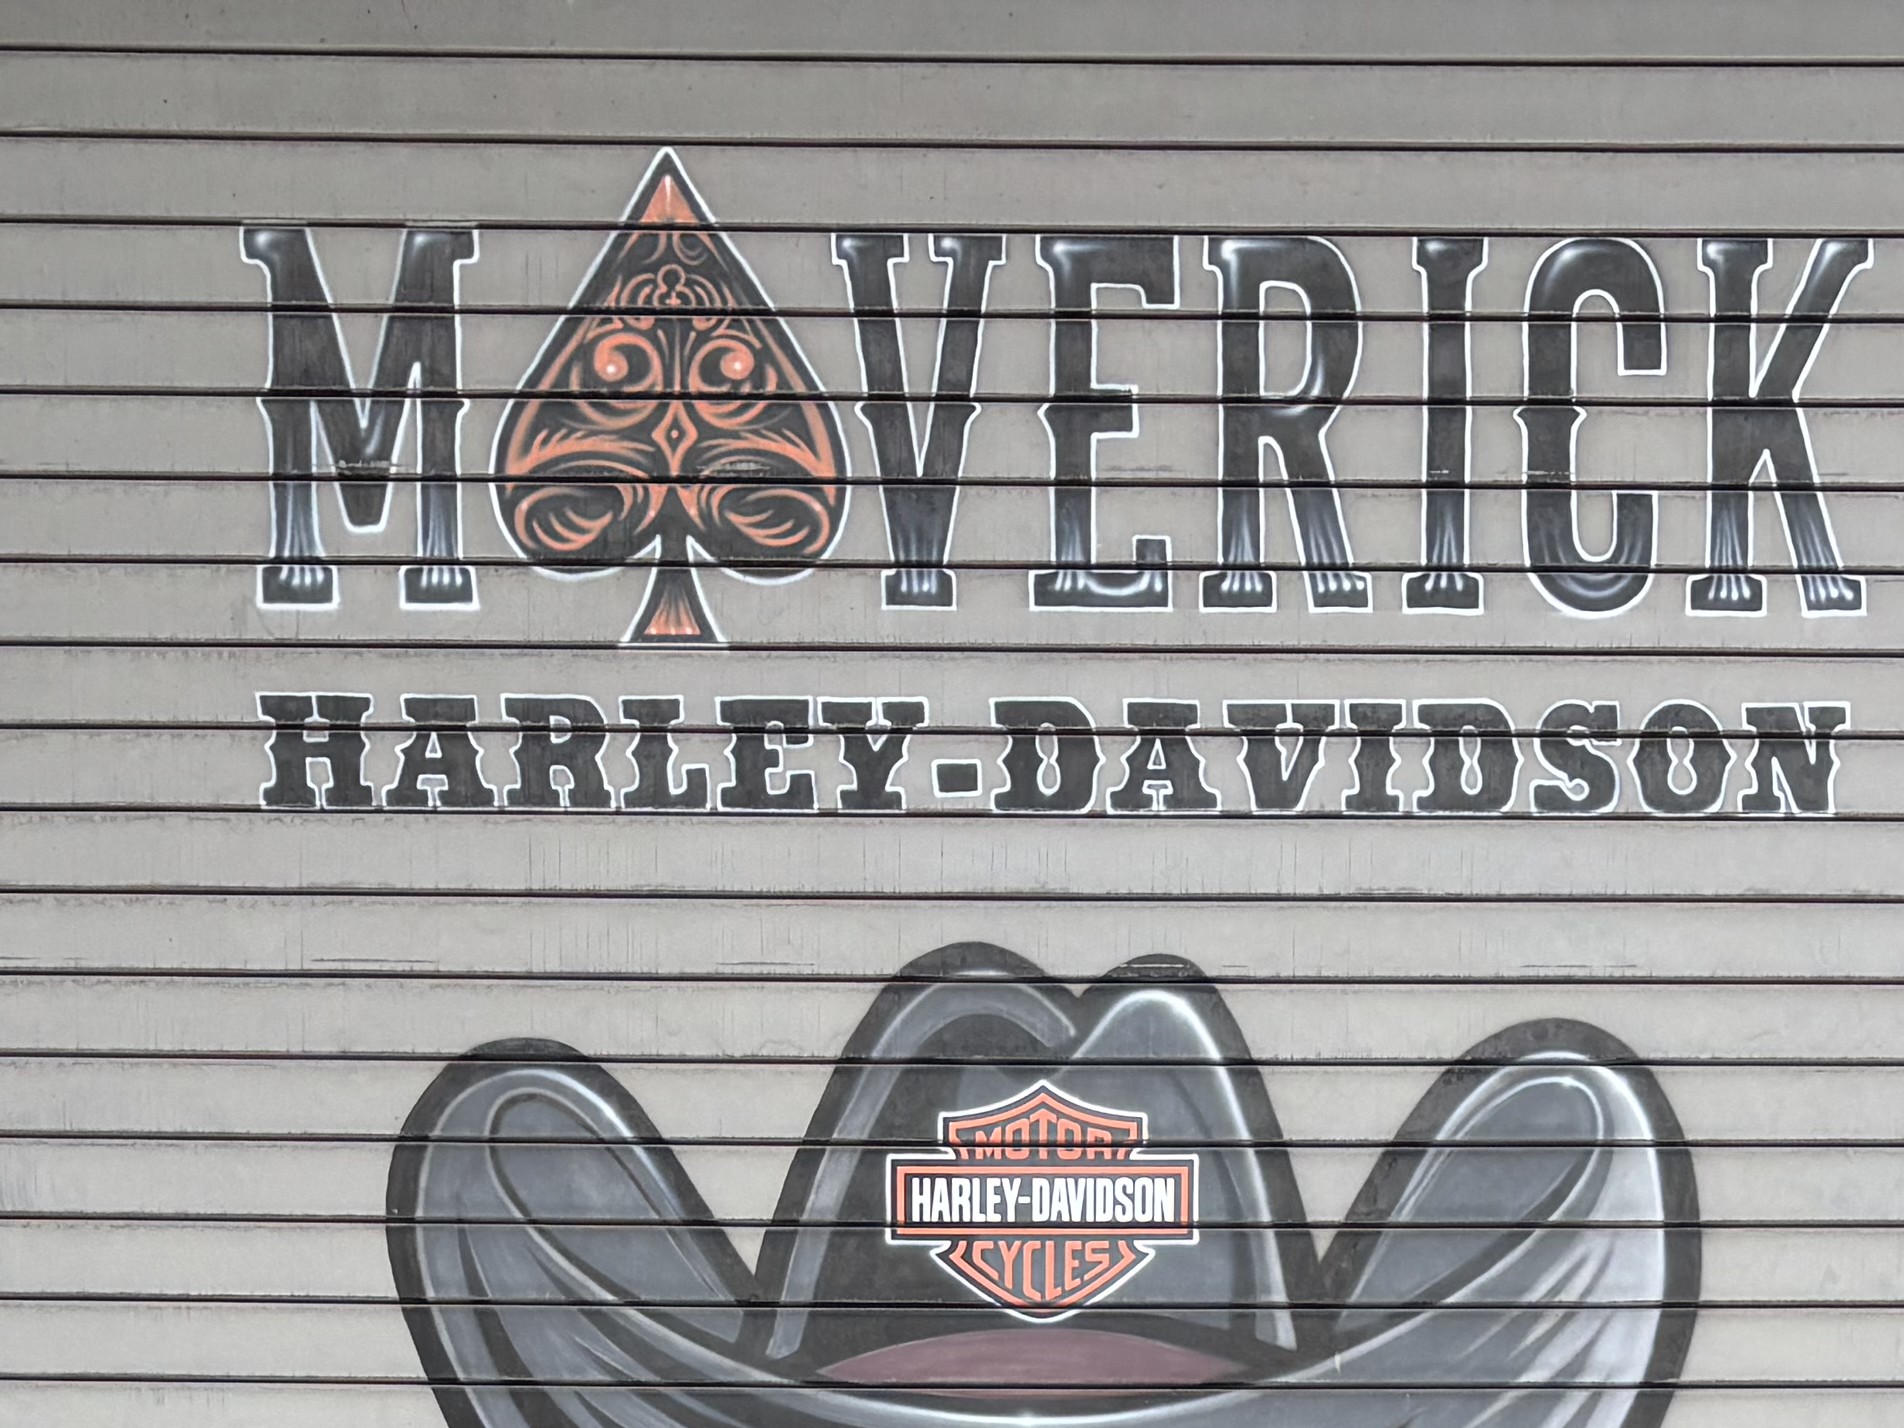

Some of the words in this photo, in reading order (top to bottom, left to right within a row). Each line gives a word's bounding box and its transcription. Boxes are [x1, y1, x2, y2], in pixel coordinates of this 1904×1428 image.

[255, 692, 1852, 818] HARLEY-DAVIDSON
[975, 1108, 1113, 1160] MOTOR
[911, 1176, 1176, 1223] HARLEY-DAVIDSON
[972, 1239, 1111, 1301] CYCLES
